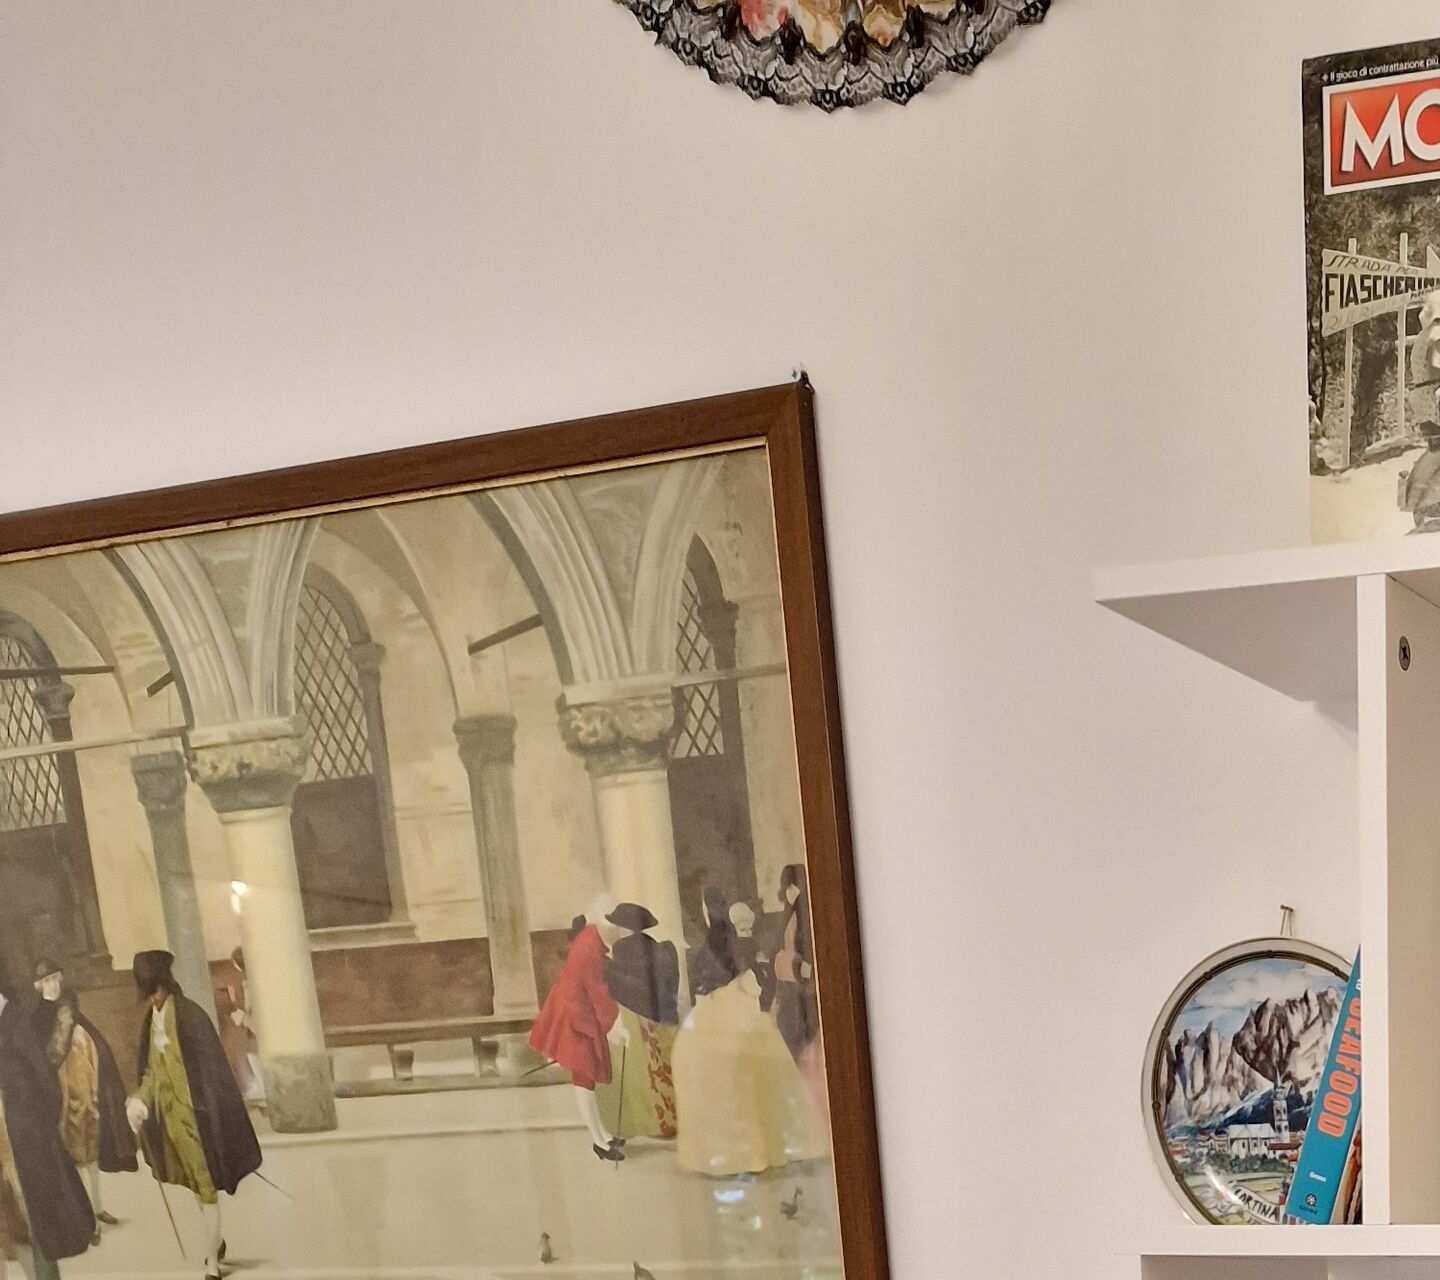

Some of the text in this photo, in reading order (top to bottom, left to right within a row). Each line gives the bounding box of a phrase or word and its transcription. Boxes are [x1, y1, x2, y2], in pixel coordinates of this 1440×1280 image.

[1336, 69, 1358, 83] gioco
[1369, 59, 1425, 76] contrattazione
[1426, 56, 1439, 69] più
[1325, 254, 1392, 272] STRADA
[1234, 1187, 1280, 1224] CORTINA
